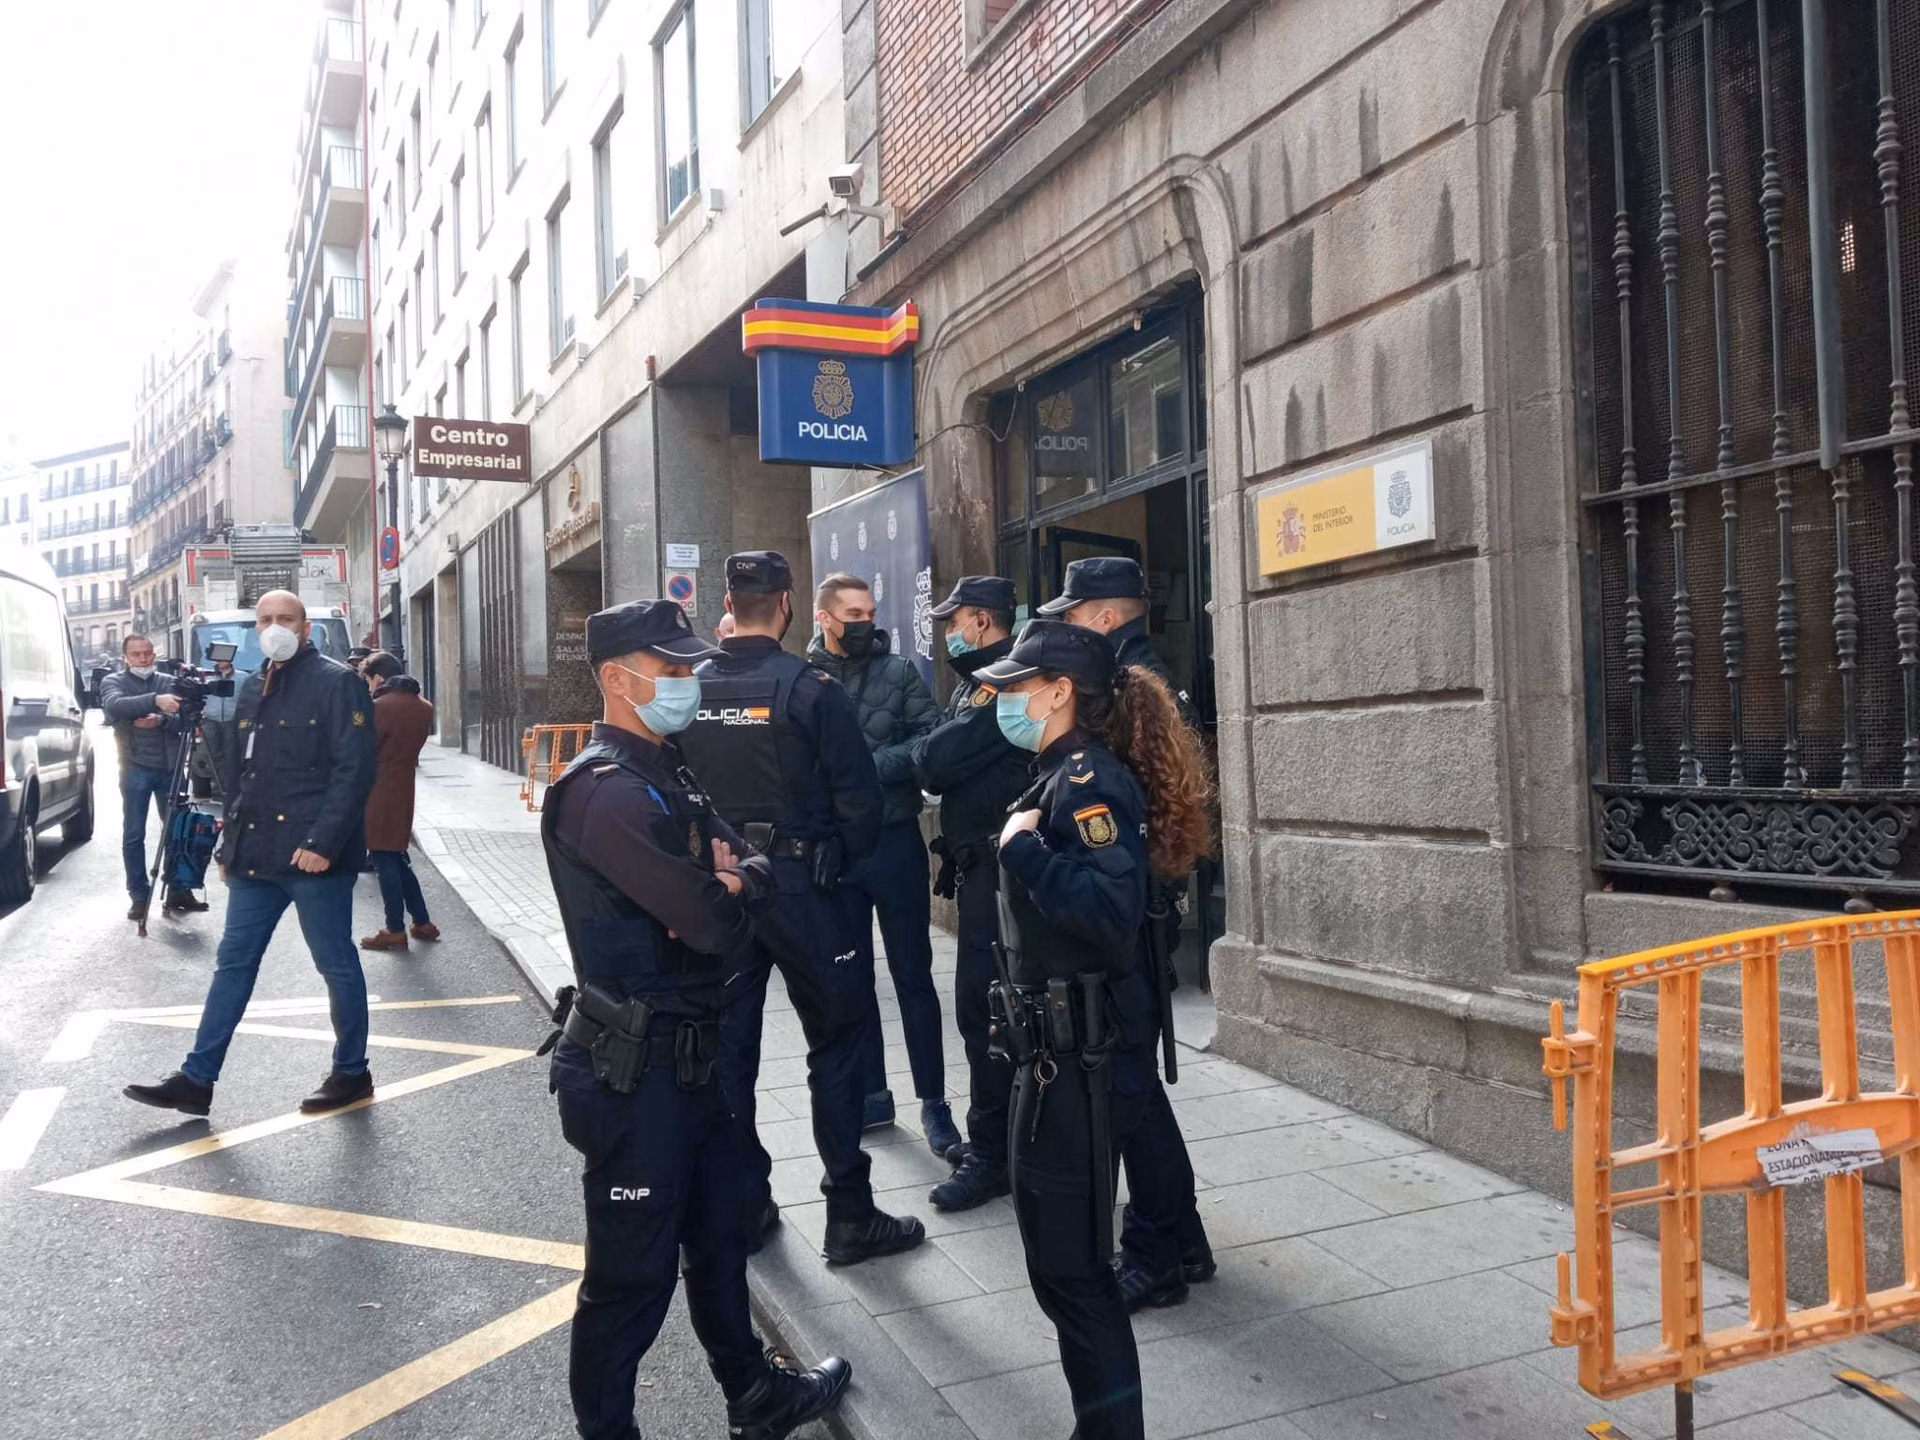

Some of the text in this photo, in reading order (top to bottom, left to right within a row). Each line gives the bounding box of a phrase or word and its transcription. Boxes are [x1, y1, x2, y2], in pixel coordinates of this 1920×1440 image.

[430, 425, 509, 447] Centro
[798, 421, 868, 442] POLICIA
[418, 448, 522, 470] Empresarial
[1312, 506, 1346, 521] MINISTERIO
[1313, 515, 1353, 533] DEL INTERIOR
[1387, 523, 1416, 536] POLICIA
[736, 562, 757, 570] CNP
[556, 632, 586, 640] DESPAC
[555, 653, 590, 661] REUNIO
[696, 708, 750, 721] OLICIA
[610, 1187, 650, 1200] CNP
